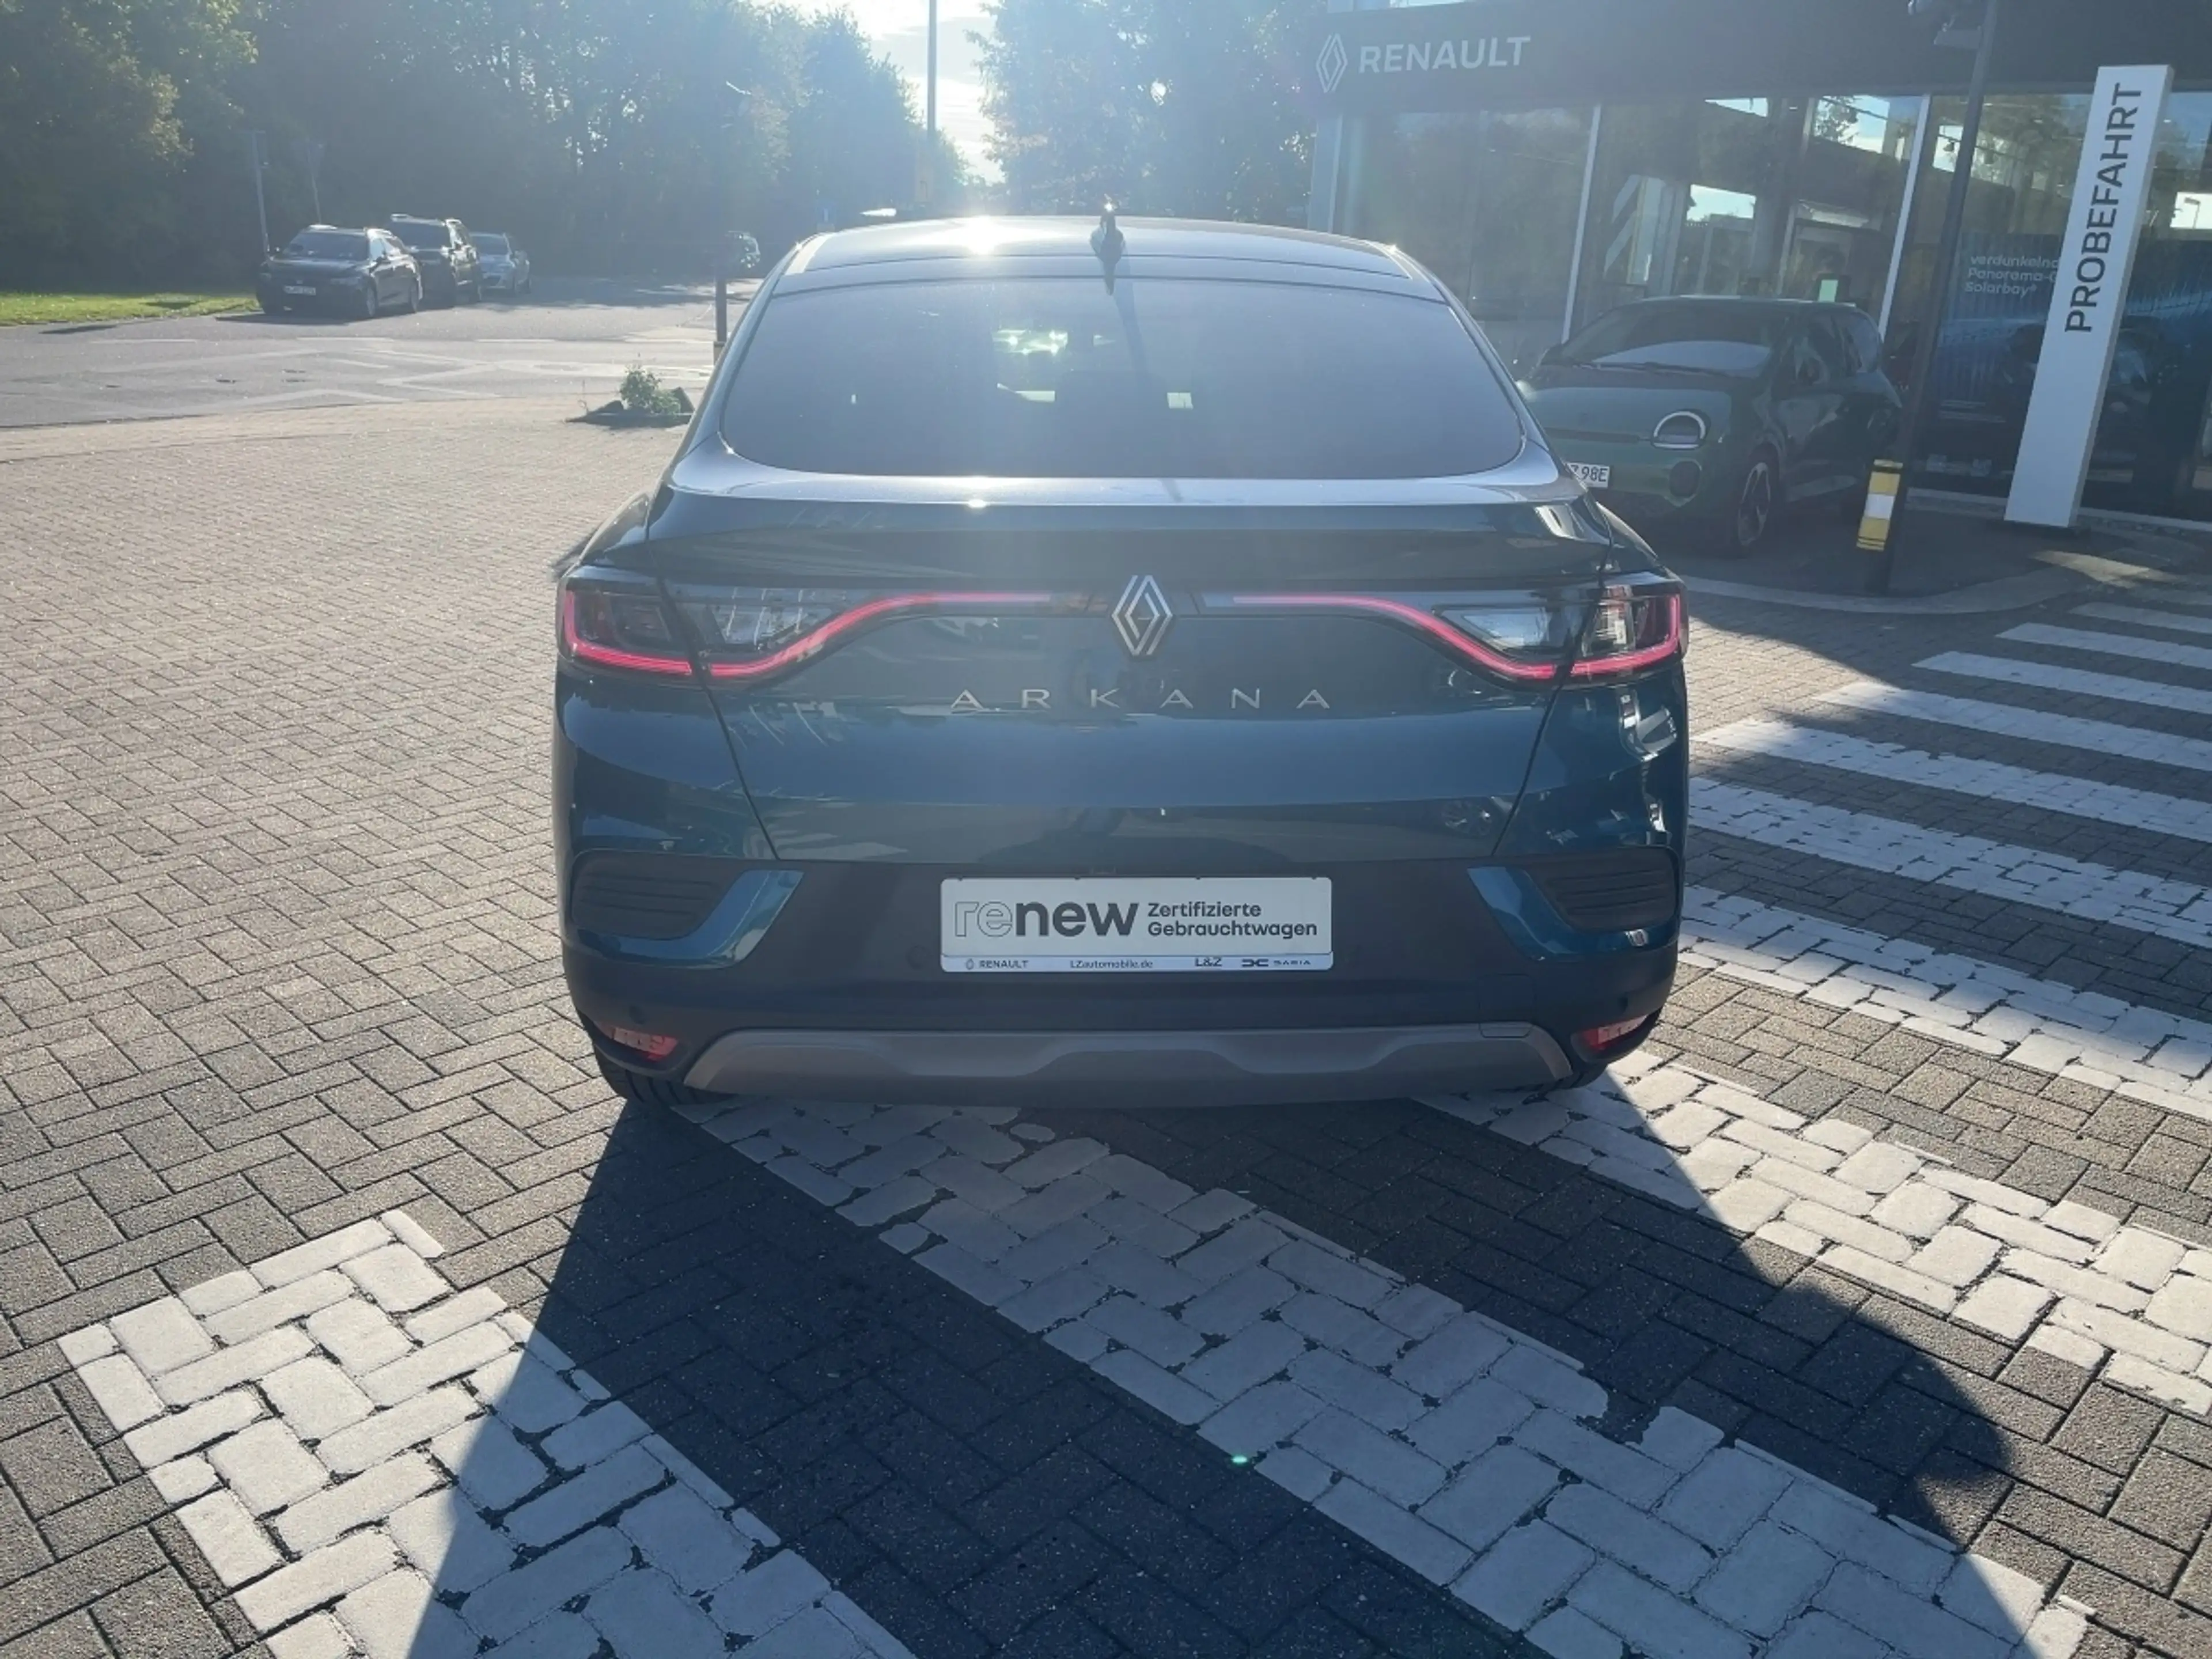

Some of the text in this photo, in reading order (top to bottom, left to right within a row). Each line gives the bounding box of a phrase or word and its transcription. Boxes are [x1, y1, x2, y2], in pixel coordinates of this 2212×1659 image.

[1358, 36, 1530, 73] RENAULT
[2065, 82, 2142, 332] PROBEFAHRT
[1581, 465, 1608, 482] 98E
[951, 687, 1330, 709] ARKANA
[1147, 902, 1262, 917] Zertifizierte
[955, 901, 1139, 937] renew
[1147, 921, 1317, 940] Gebrauchtwagen
[979, 960, 1029, 969] RENAULT
[1070, 960, 1153, 969] LZautomobile.de
[1194, 957, 1222, 967] L&Z
